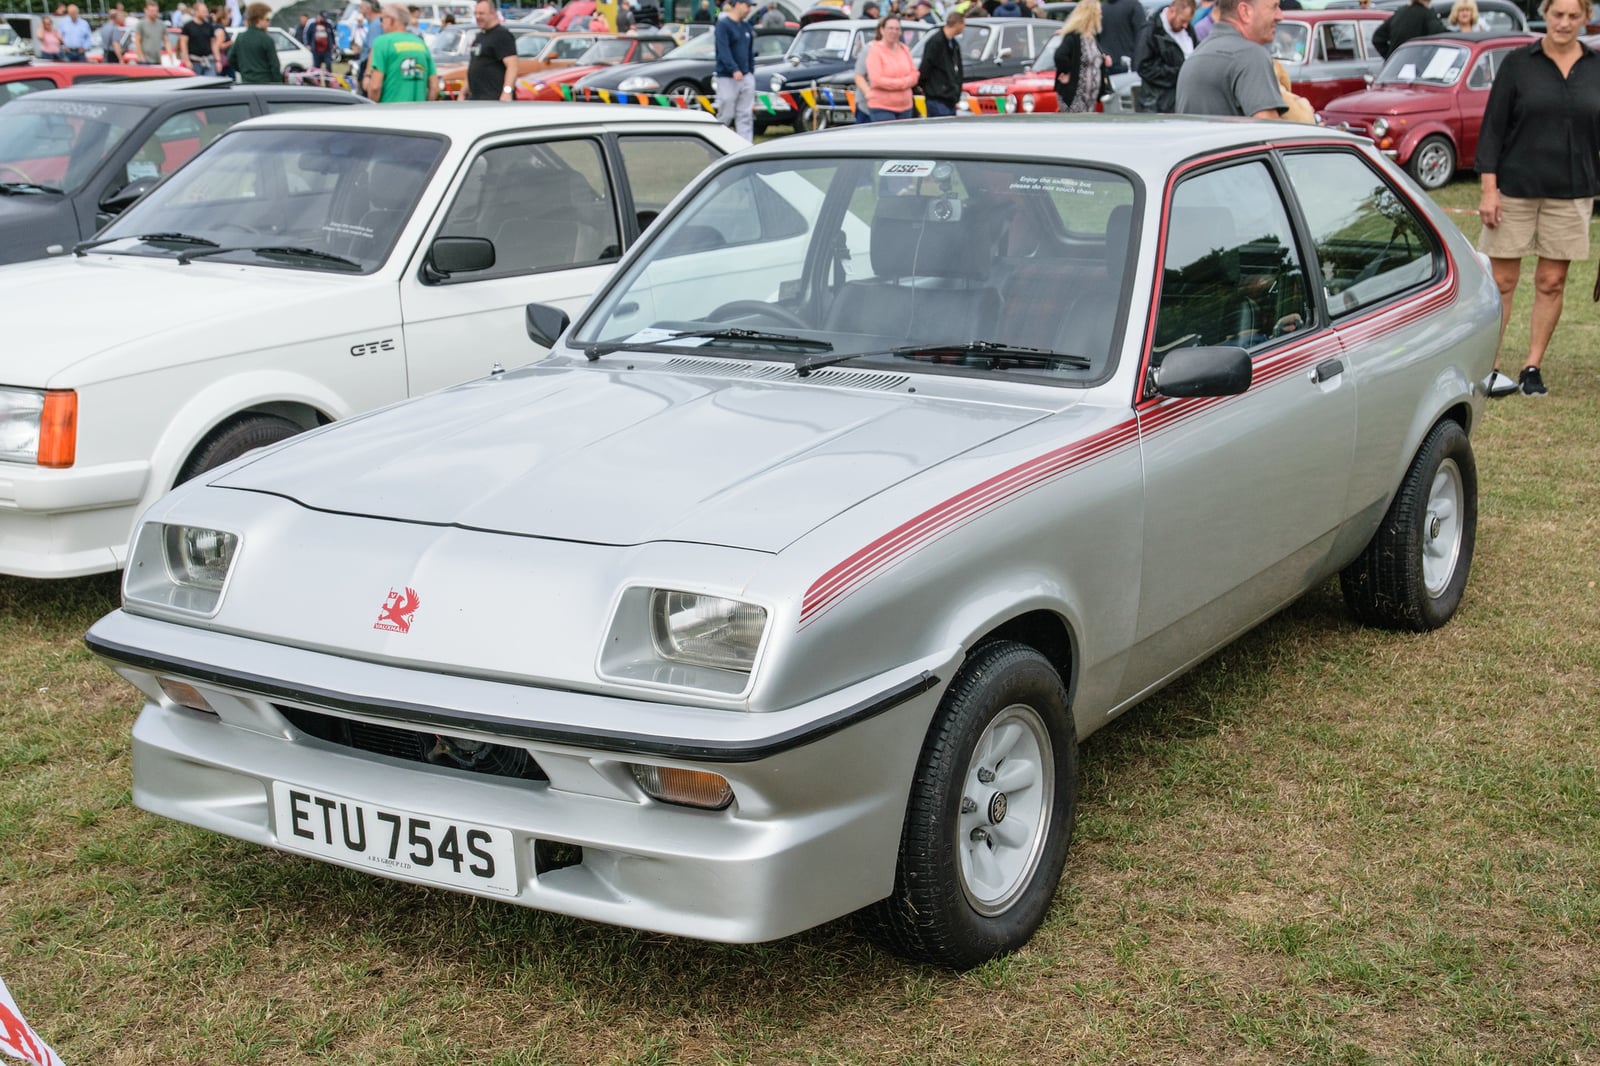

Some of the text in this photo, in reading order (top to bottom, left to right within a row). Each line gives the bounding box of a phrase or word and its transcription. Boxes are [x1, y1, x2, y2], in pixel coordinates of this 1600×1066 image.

[350, 339, 395, 356] GTE
[374, 622, 407, 633] VAUXHALL
[289, 789, 496, 879] ETU 754S
